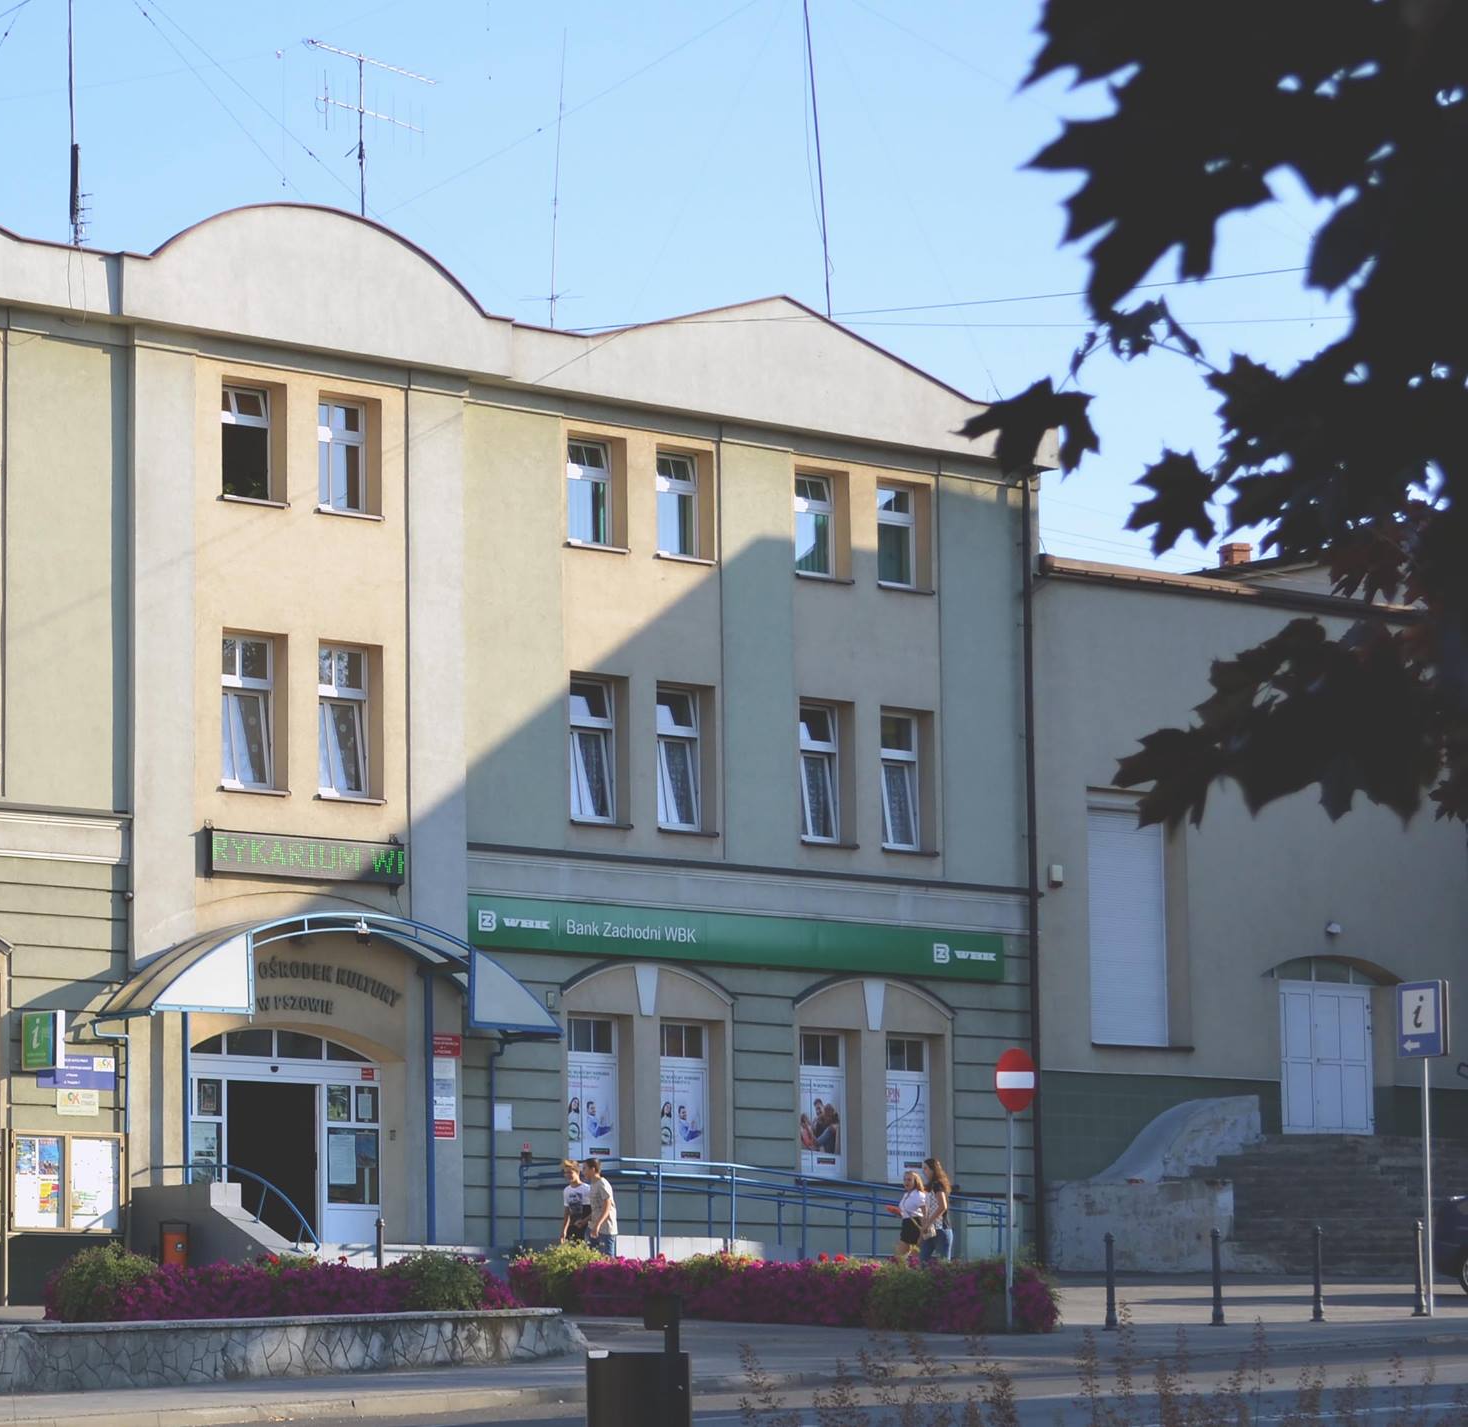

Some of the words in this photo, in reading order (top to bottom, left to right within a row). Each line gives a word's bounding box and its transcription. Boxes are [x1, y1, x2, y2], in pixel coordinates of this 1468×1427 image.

[566, 919, 599, 936] Bank
[603, 922, 661, 941] Zachodni
[666, 928, 697, 944] WBK
[258, 956, 333, 983] OŚRODEK
[335, 967, 403, 1008] KULTURY
[274, 995, 334, 1015] PSZOWIE
